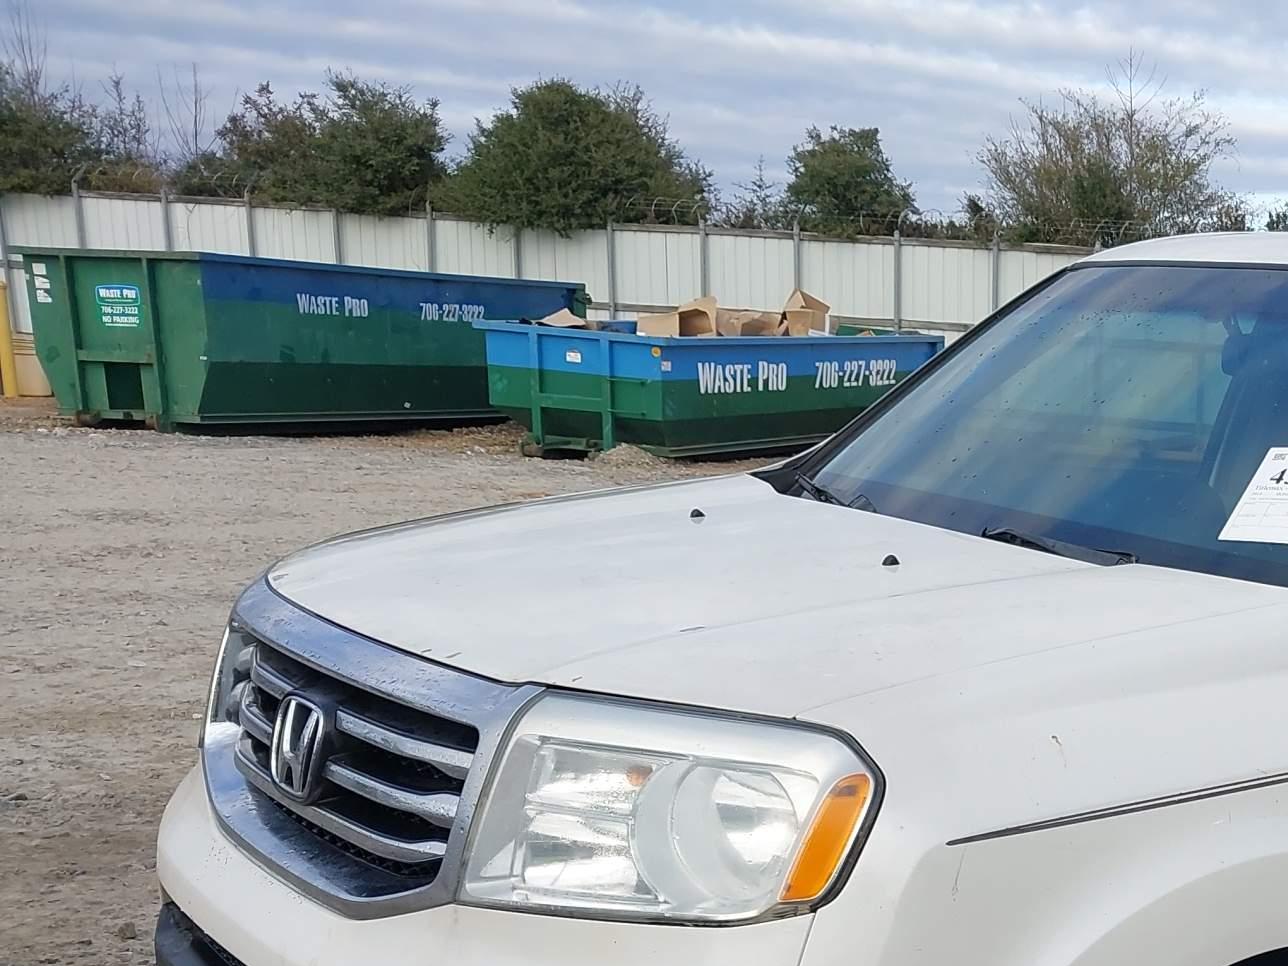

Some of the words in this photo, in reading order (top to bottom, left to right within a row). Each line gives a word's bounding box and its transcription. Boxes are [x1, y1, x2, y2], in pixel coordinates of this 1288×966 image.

[98, 288, 121, 298] WASTE
[123, 288, 136, 298] PRO
[297, 293, 340, 316] WASTE
[344, 296, 369, 318] PRO
[419, 303, 485, 322] 706-227-3222
[697, 361, 751, 395] WASTE
[758, 360, 788, 392] PRO
[815, 359, 897, 390] 706-227-3222
